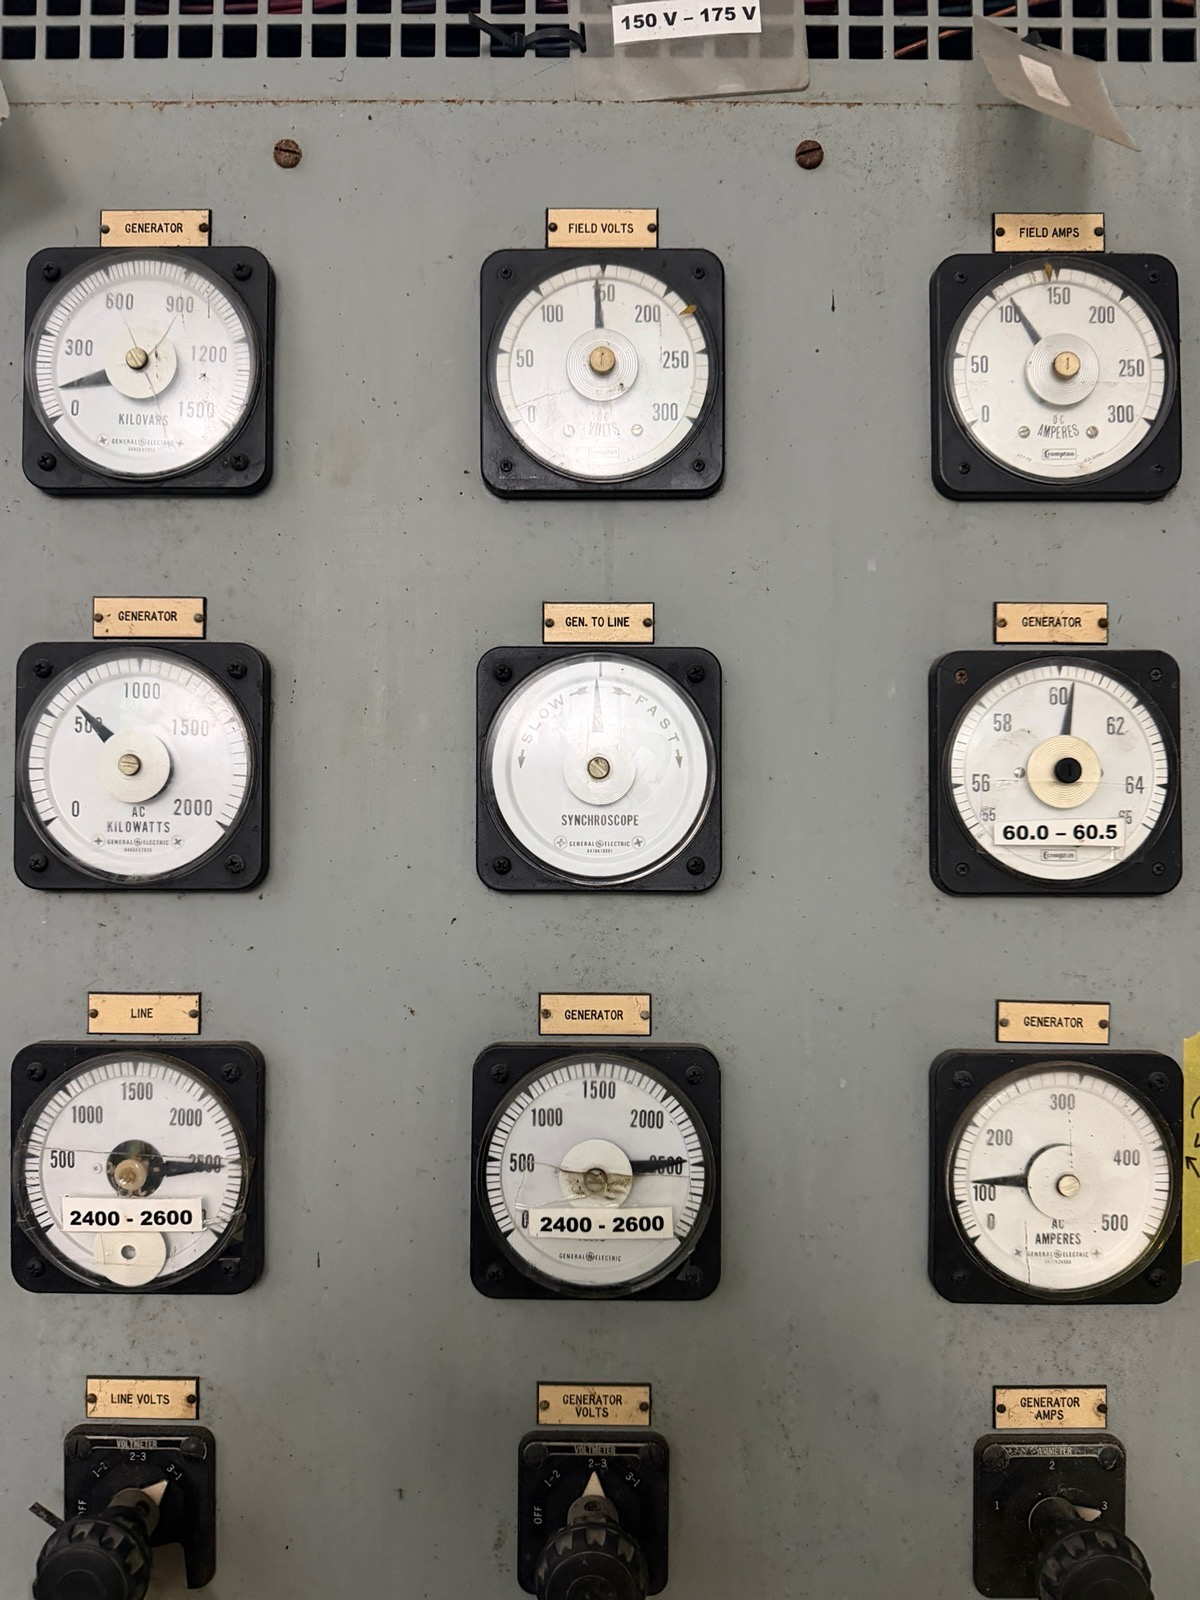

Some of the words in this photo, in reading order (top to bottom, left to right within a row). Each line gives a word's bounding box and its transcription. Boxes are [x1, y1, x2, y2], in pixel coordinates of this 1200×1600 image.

[621, 13, 657, 30] 150
[663, 11, 677, 26] V
[699, 7, 736, 23] 175
[742, 6, 756, 20] V
[124, 222, 184, 234] GENERATOR
[568, 222, 598, 234] FIELD
[601, 222, 634, 234] VOLTS
[1019, 227, 1049, 239] FIELD
[1052, 227, 1080, 239] AMPS
[105, 293, 134, 311] 600
[166, 295, 194, 314] 900
[1047, 287, 1071, 305] 150
[542, 304, 563, 323] 100
[634, 304, 661, 323] 200
[1088, 306, 1116, 324] 200
[64, 339, 93, 357] 300
[190, 345, 228, 364] 1200
[516, 350, 534, 368] 50
[662, 350, 690, 369] 250
[971, 355, 989, 374] 50
[1119, 359, 1145, 378] 250
[70, 400, 80, 417] 0
[178, 400, 215, 419] 1500
[527, 406, 536, 423] 0
[652, 403, 679, 422] 300
[981, 405, 990, 423] 0
[1107, 405, 1134, 423] 300
[118, 413, 169, 426] KILOVARS
[588, 421, 619, 437] VOLTS
[1037, 423, 1080, 440] AMPERES
[118, 610, 178, 622] GENERATOR
[565, 616, 588, 628] GEN.
[591, 616, 605, 628] TO
[608, 616, 630, 628] LINE
[1021, 617, 1082, 628] GENERATOR
[124, 682, 161, 700] 1000
[1049, 687, 1068, 706] 60
[172, 719, 209, 737] 1500
[521, 694, 565, 745] SLOW
[634, 695, 680, 743] FAST
[993, 713, 1012, 732] 58
[1106, 716, 1125, 736] 62
[971, 774, 990, 793] 56
[1125, 775, 1144, 795] 64
[71, 800, 81, 818] 0
[131, 806, 146, 818] AC
[173, 799, 213, 817] 2000
[106, 821, 171, 833] KILOWATTS
[561, 814, 639, 827] SYNCHROSCOPE
[1002, 824, 1049, 841] 60.0
[1072, 824, 1118, 840] 60.5
[569, 840, 595, 848] GENERAL
[604, 840, 631, 848] ELECTRIC
[130, 1007, 154, 1019] LINE
[564, 1009, 624, 1021] GENERATOR
[1023, 1016, 1084, 1028] GENERATOR
[121, 1081, 153, 1101] 1500
[582, 1080, 616, 1100] 1500
[1049, 1093, 1076, 1111] 300
[71, 1105, 104, 1124] 1000
[169, 1107, 203, 1127] 2000
[531, 1107, 564, 1127] 1000
[630, 1110, 665, 1129] 2000
[986, 1129, 1013, 1147] 200
[50, 1150, 76, 1169] 500
[509, 1153, 535, 1173] 500
[1113, 1149, 1140, 1167] 400
[972, 1184, 997, 1202] 100
[69, 1211, 120, 1226] 2400
[140, 1209, 193, 1226] 2600
[540, 1216, 592, 1233] 2400
[612, 1215, 665, 1232] 2600
[985, 1213, 997, 1231] 0
[1051, 1218, 1065, 1230] AC
[1101, 1214, 1129, 1232] 500
[1034, 1232, 1082, 1246] AMPERES
[558, 1252, 586, 1260] GENERAL
[595, 1254, 622, 1262] ELECTRIC
[110, 1393, 133, 1405] LINE
[137, 1393, 170, 1406] VOLTS
[562, 1394, 623, 1406] GENERATOR
[1020, 1396, 1081, 1408] GENERATOR
[575, 1406, 609, 1418] VOLTS
[1034, 1408, 1065, 1421] AMPS
[116, 1439, 158, 1449] VOLTMETER
[573, 1445, 616, 1455] VOLTMETER
[129, 1451, 147, 1462] 2-3
[588, 1458, 608, 1468] 2-3
[1048, 1460, 1056, 1470] 2
[92, 1461, 109, 1478] 1-2
[166, 1463, 183, 1481] 3-1
[543, 1469, 562, 1488] 1-2
[624, 1471, 641, 1488] 3-1
[77, 1499, 88, 1516] FF
[994, 1500, 1000, 1510] 1
[1101, 1501, 1108, 1510] 3
[533, 1505, 543, 1525] OFF
